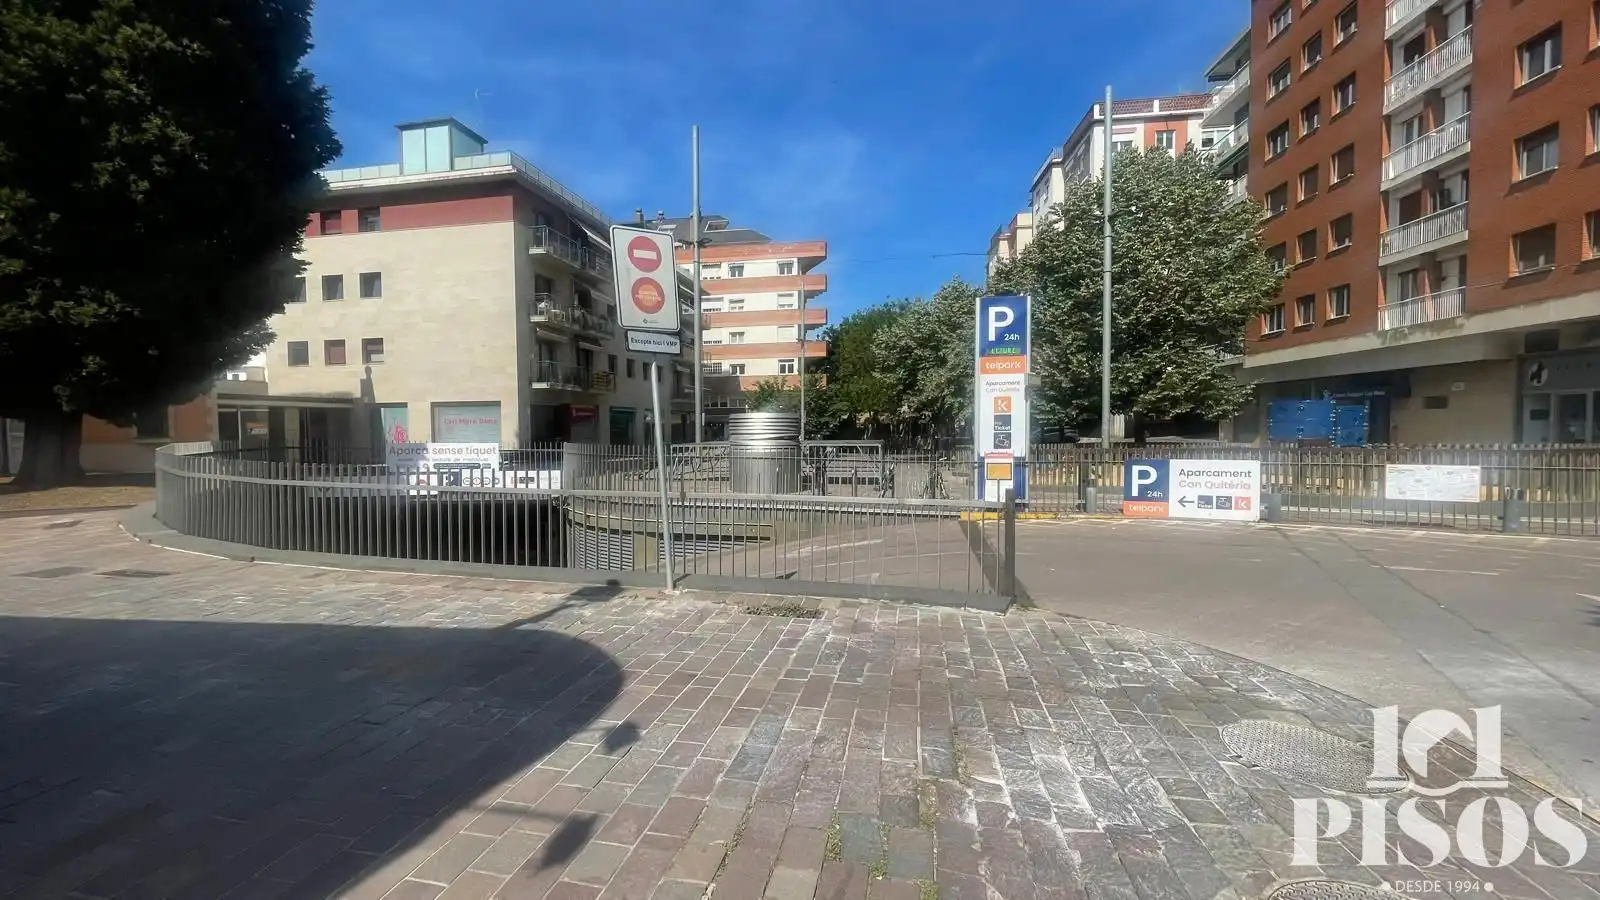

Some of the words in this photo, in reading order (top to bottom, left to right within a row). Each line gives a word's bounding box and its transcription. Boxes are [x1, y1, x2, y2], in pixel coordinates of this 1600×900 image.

[988, 306, 1015, 342] P
[1004, 333, 1020, 341] 24h
[985, 361, 1021, 370] telpark
[389, 446, 428, 456] Aparca
[432, 447, 463, 455] sense
[465, 446, 497, 457] tiquet
[1178, 468, 1252, 479] Aparcament
[1131, 465, 1158, 497] P
[1178, 480, 1202, 489] Can
[1147, 490, 1164, 498] 24h
[1128, 504, 1164, 513] telpark
